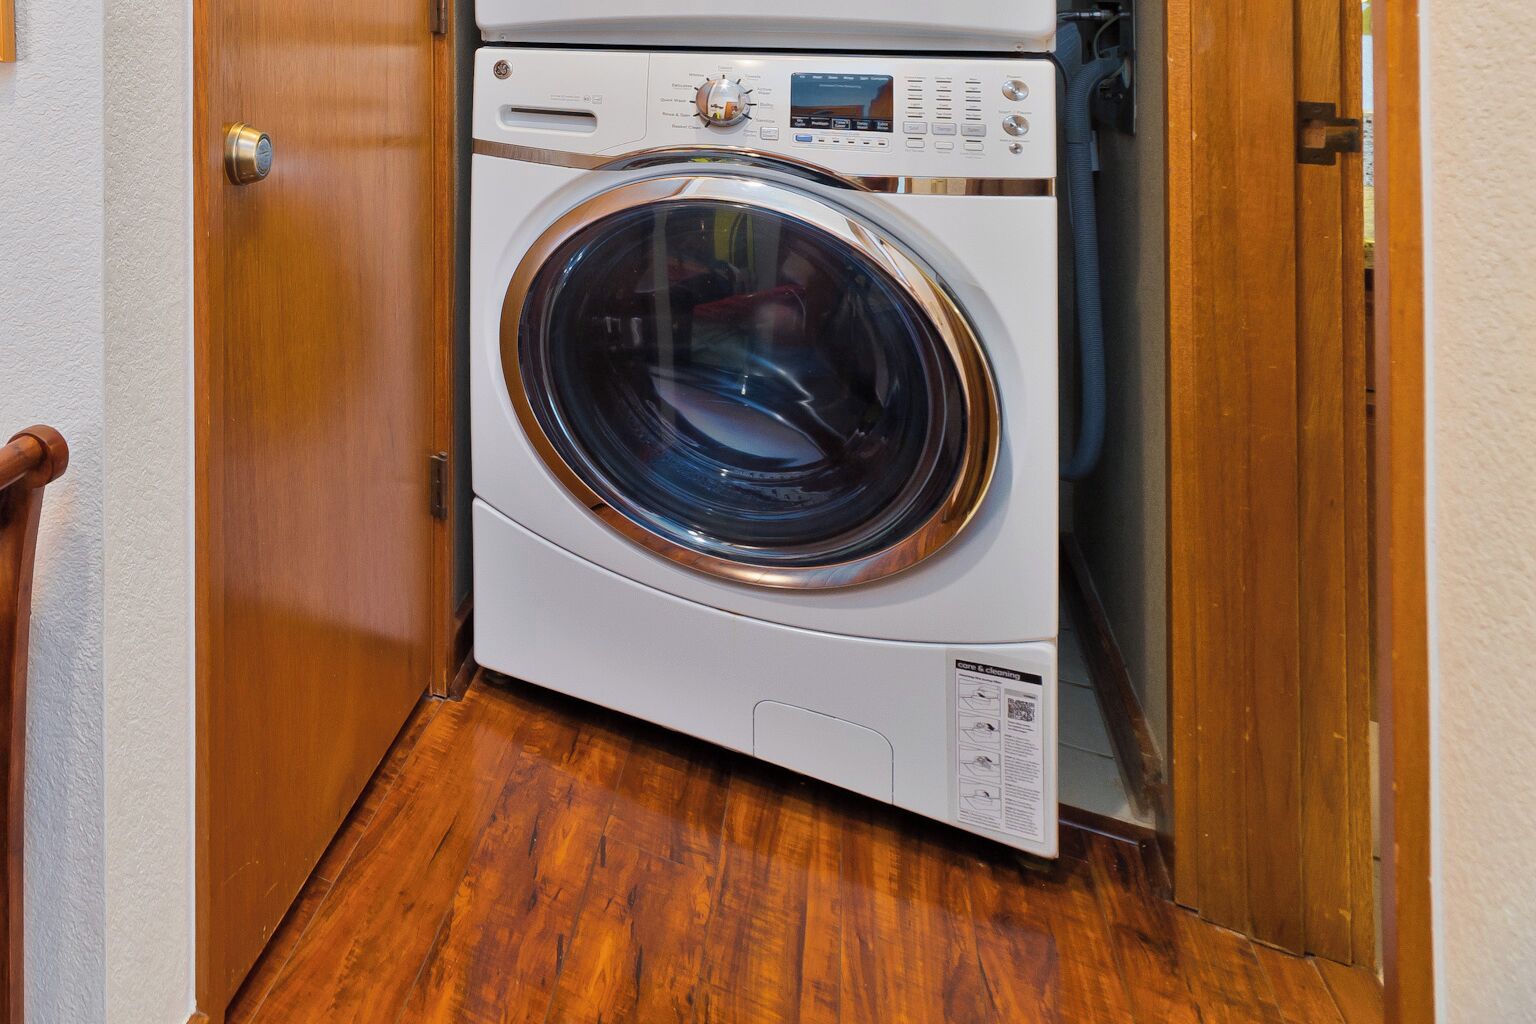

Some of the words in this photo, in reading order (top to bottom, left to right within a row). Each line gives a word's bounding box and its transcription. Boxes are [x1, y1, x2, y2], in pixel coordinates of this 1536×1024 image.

[957, 662, 977, 671] care
[977, 665, 984, 673] &
[985, 666, 1021, 681] cleaning
